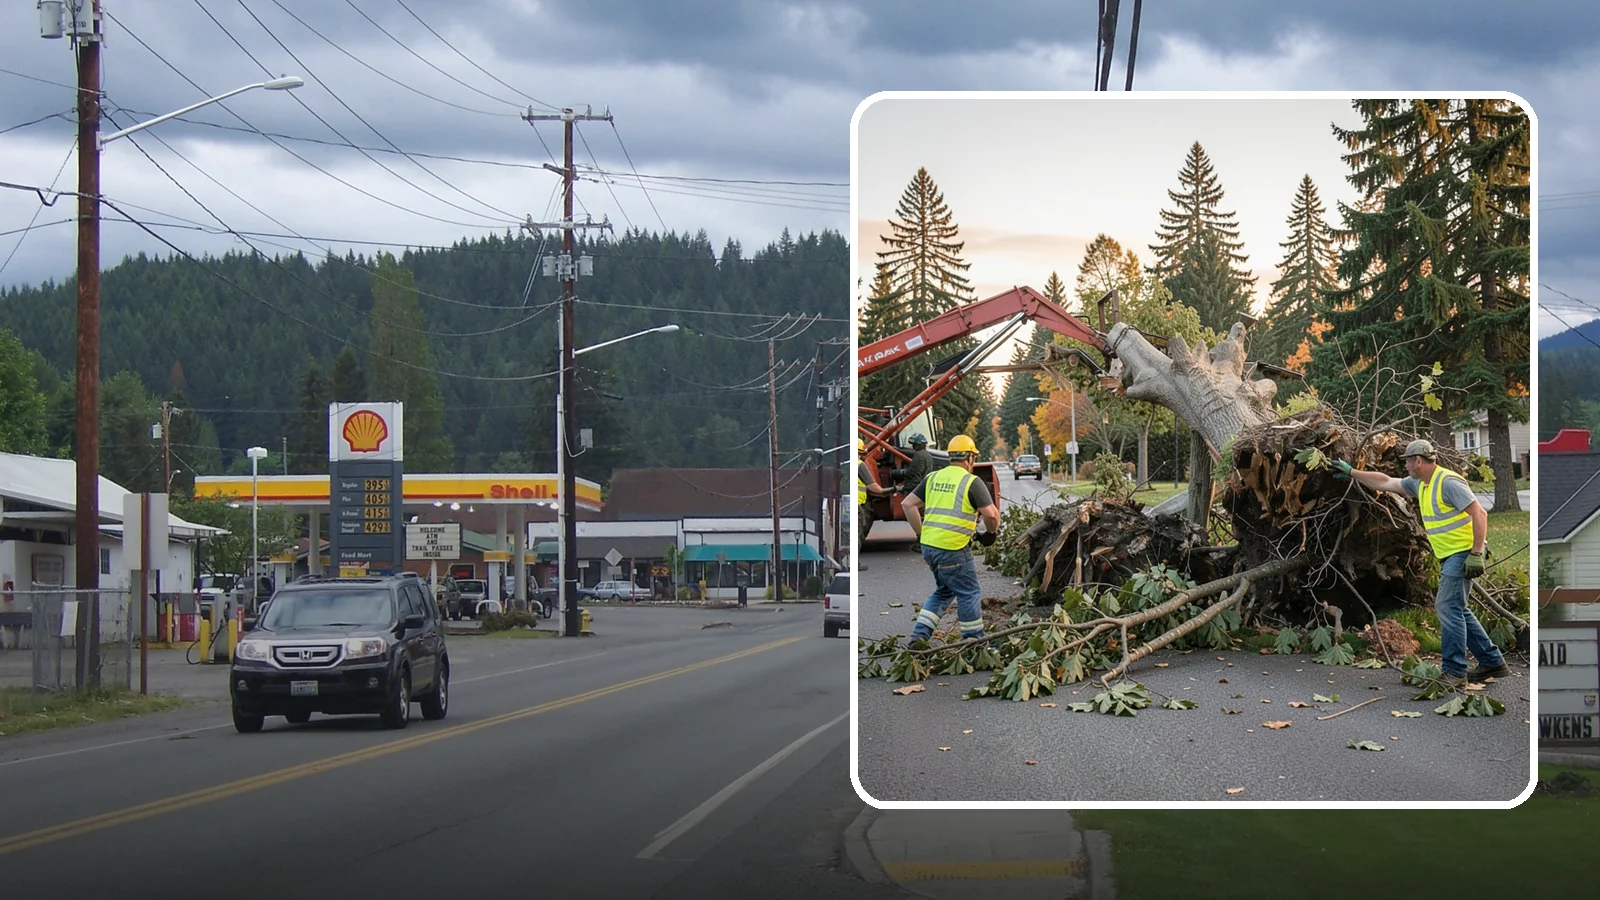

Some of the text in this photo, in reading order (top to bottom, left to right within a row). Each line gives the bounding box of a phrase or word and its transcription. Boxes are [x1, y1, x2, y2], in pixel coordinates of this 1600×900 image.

[366, 480, 383, 490] 395
[490, 484, 547, 498] Shell
[366, 494, 383, 504] 405
[366, 508, 383, 518] 415
[366, 522, 383, 532] 429
